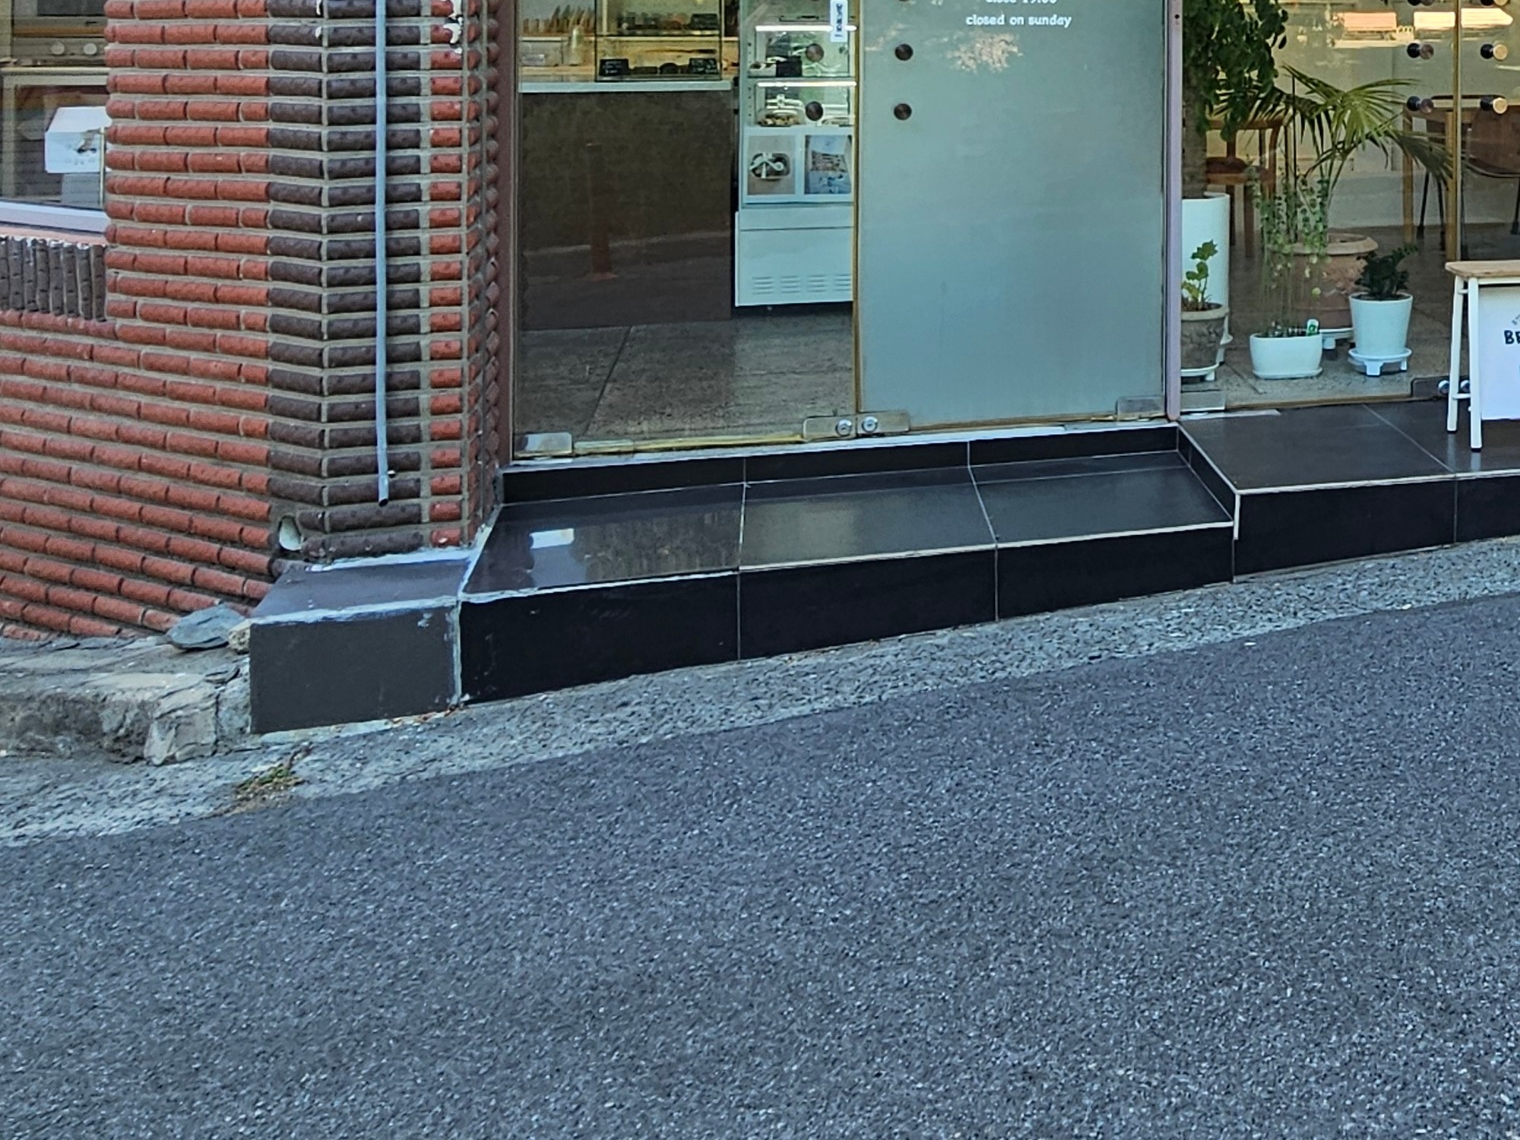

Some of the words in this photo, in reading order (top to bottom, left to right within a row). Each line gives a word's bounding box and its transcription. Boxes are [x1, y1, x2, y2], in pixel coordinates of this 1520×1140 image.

[965, 14, 1005, 25] closed
[1009, 16, 1024, 25] on
[1028, 14, 1072, 28] sunday
